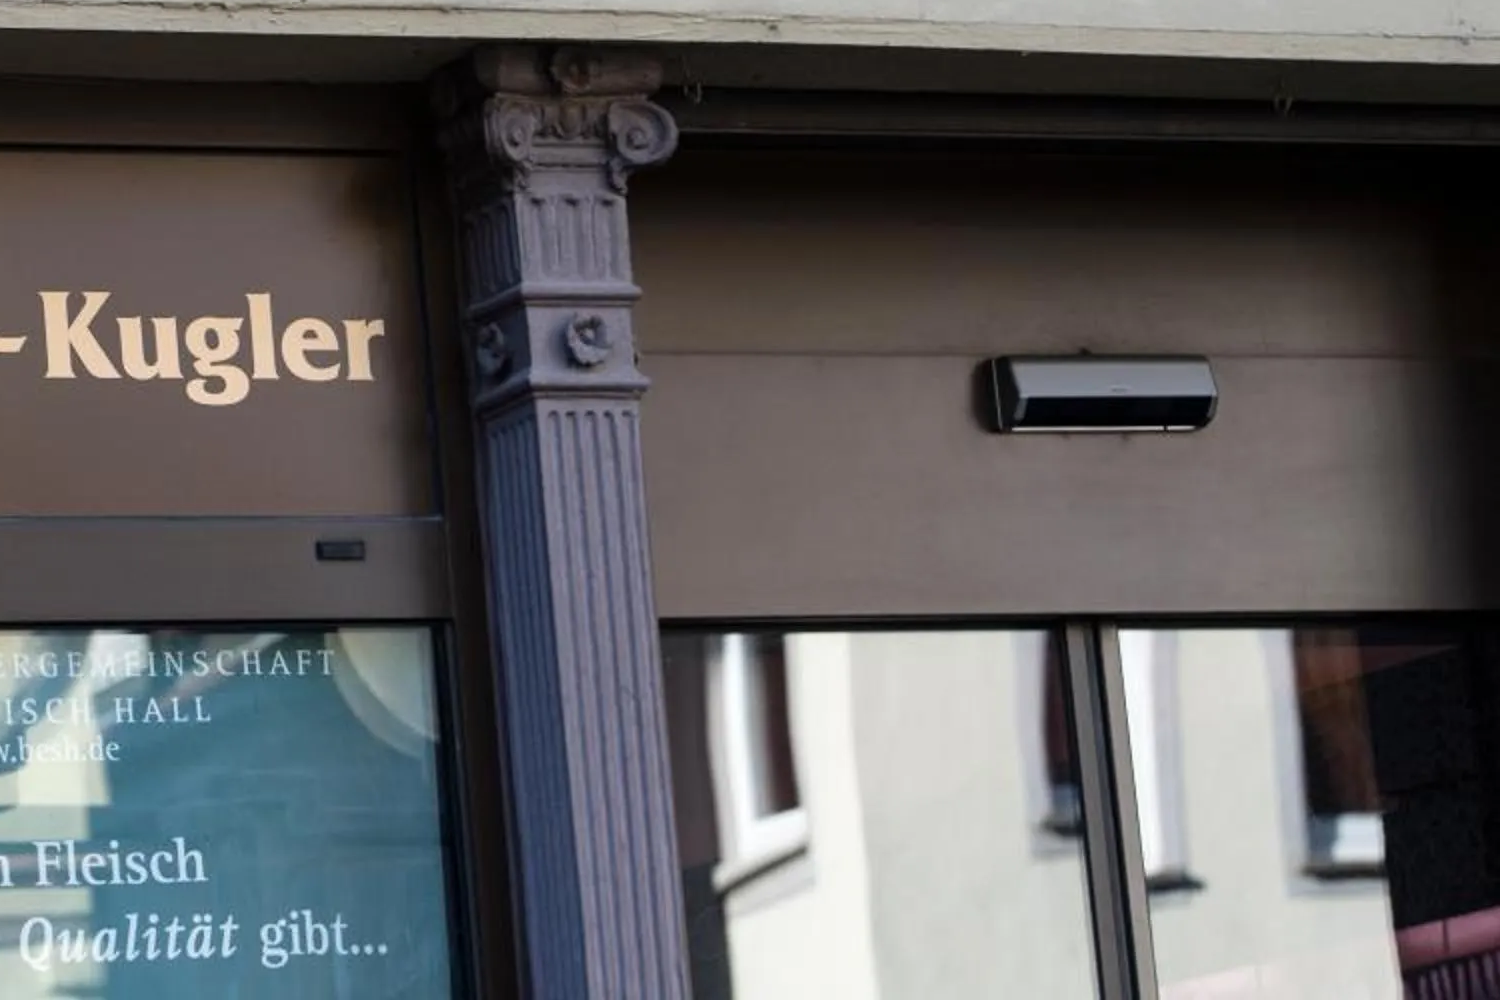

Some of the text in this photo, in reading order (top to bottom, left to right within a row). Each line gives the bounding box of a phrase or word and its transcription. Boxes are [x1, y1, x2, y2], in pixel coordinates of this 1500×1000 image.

[114, 696, 213, 724] HALL
[32, 836, 209, 887] Fleisch
[18, 912, 240, 972] Qualität
[259, 909, 388, 969] gibt...
